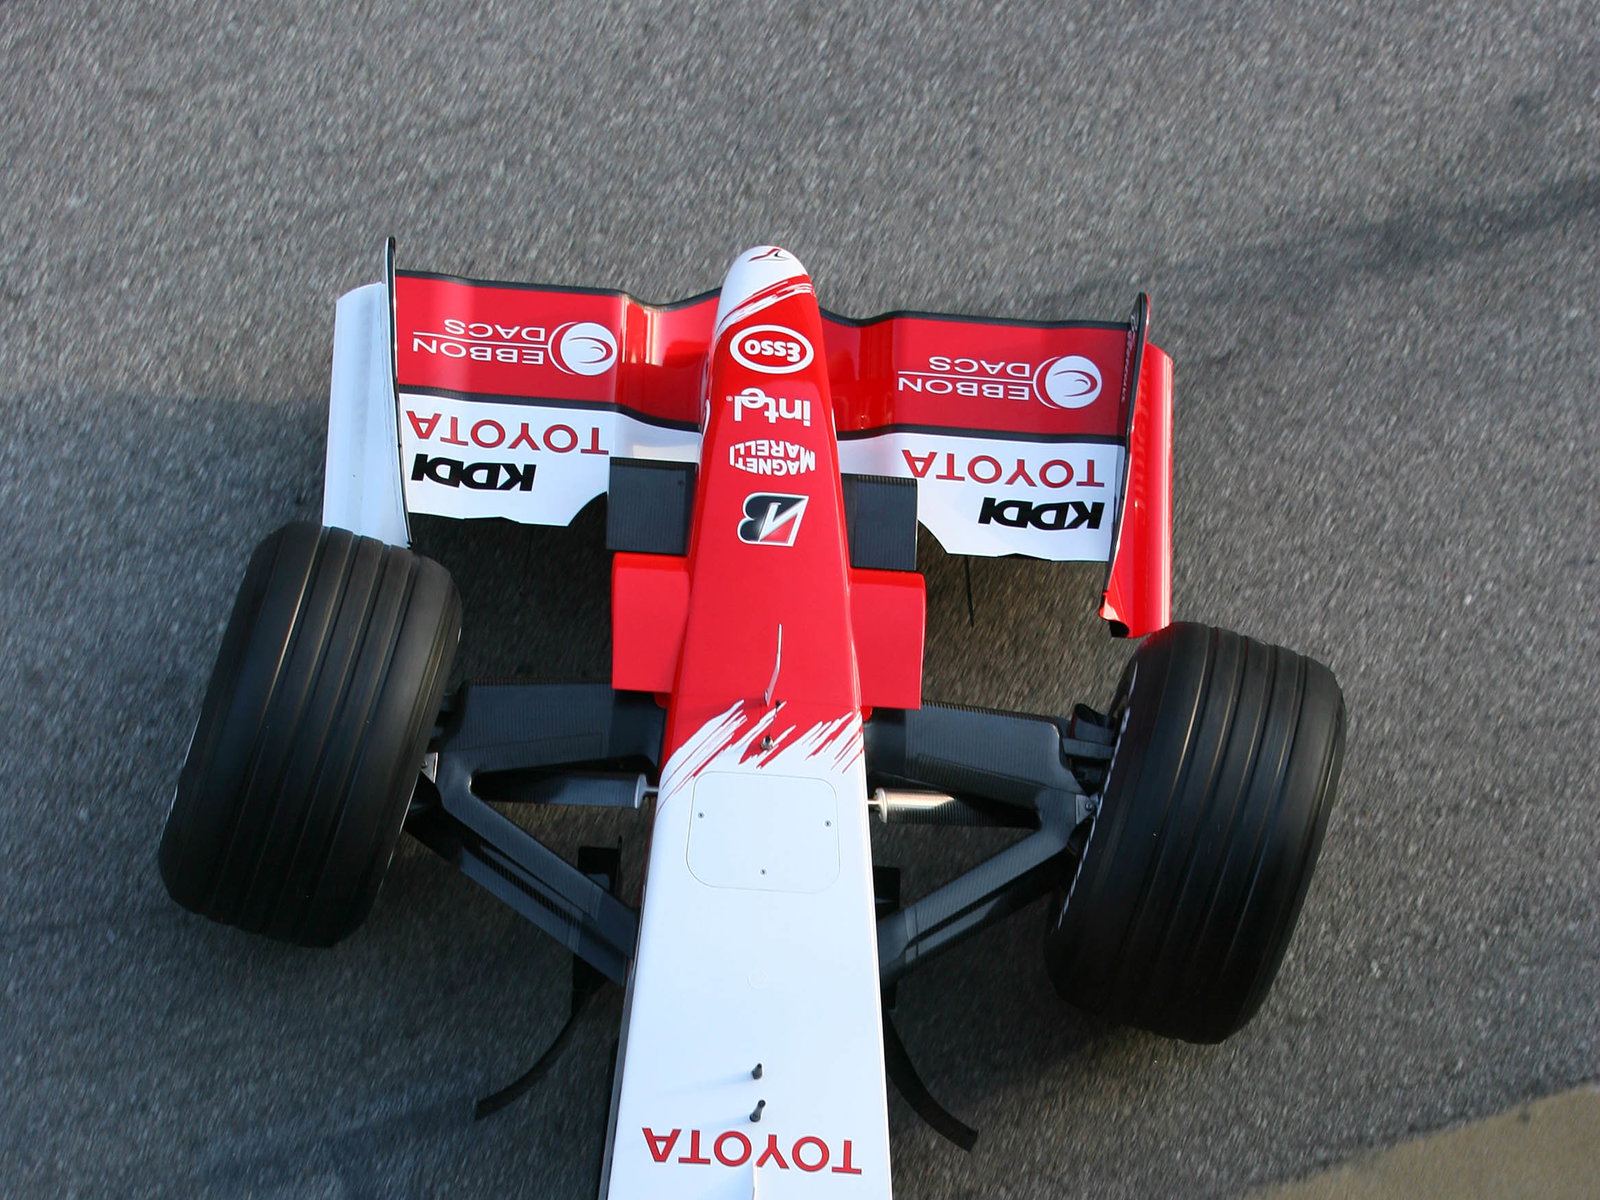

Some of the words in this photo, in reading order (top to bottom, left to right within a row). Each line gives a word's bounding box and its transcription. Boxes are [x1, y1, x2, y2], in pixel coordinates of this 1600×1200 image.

[444, 318, 546, 341] DACS
[413, 336, 544, 365] EBBON
[928, 356, 1030, 377] DACS
[898, 378, 1029, 400] EBBON
[405, 409, 609, 456] TOYOTA
[411, 453, 537, 492] KDDI
[730, 446, 816, 476] MAGNETI
[901, 449, 1105, 488] TOYOTA
[978, 496, 1105, 530] KDDI
[641, 1127, 863, 1175] TOYOTA
